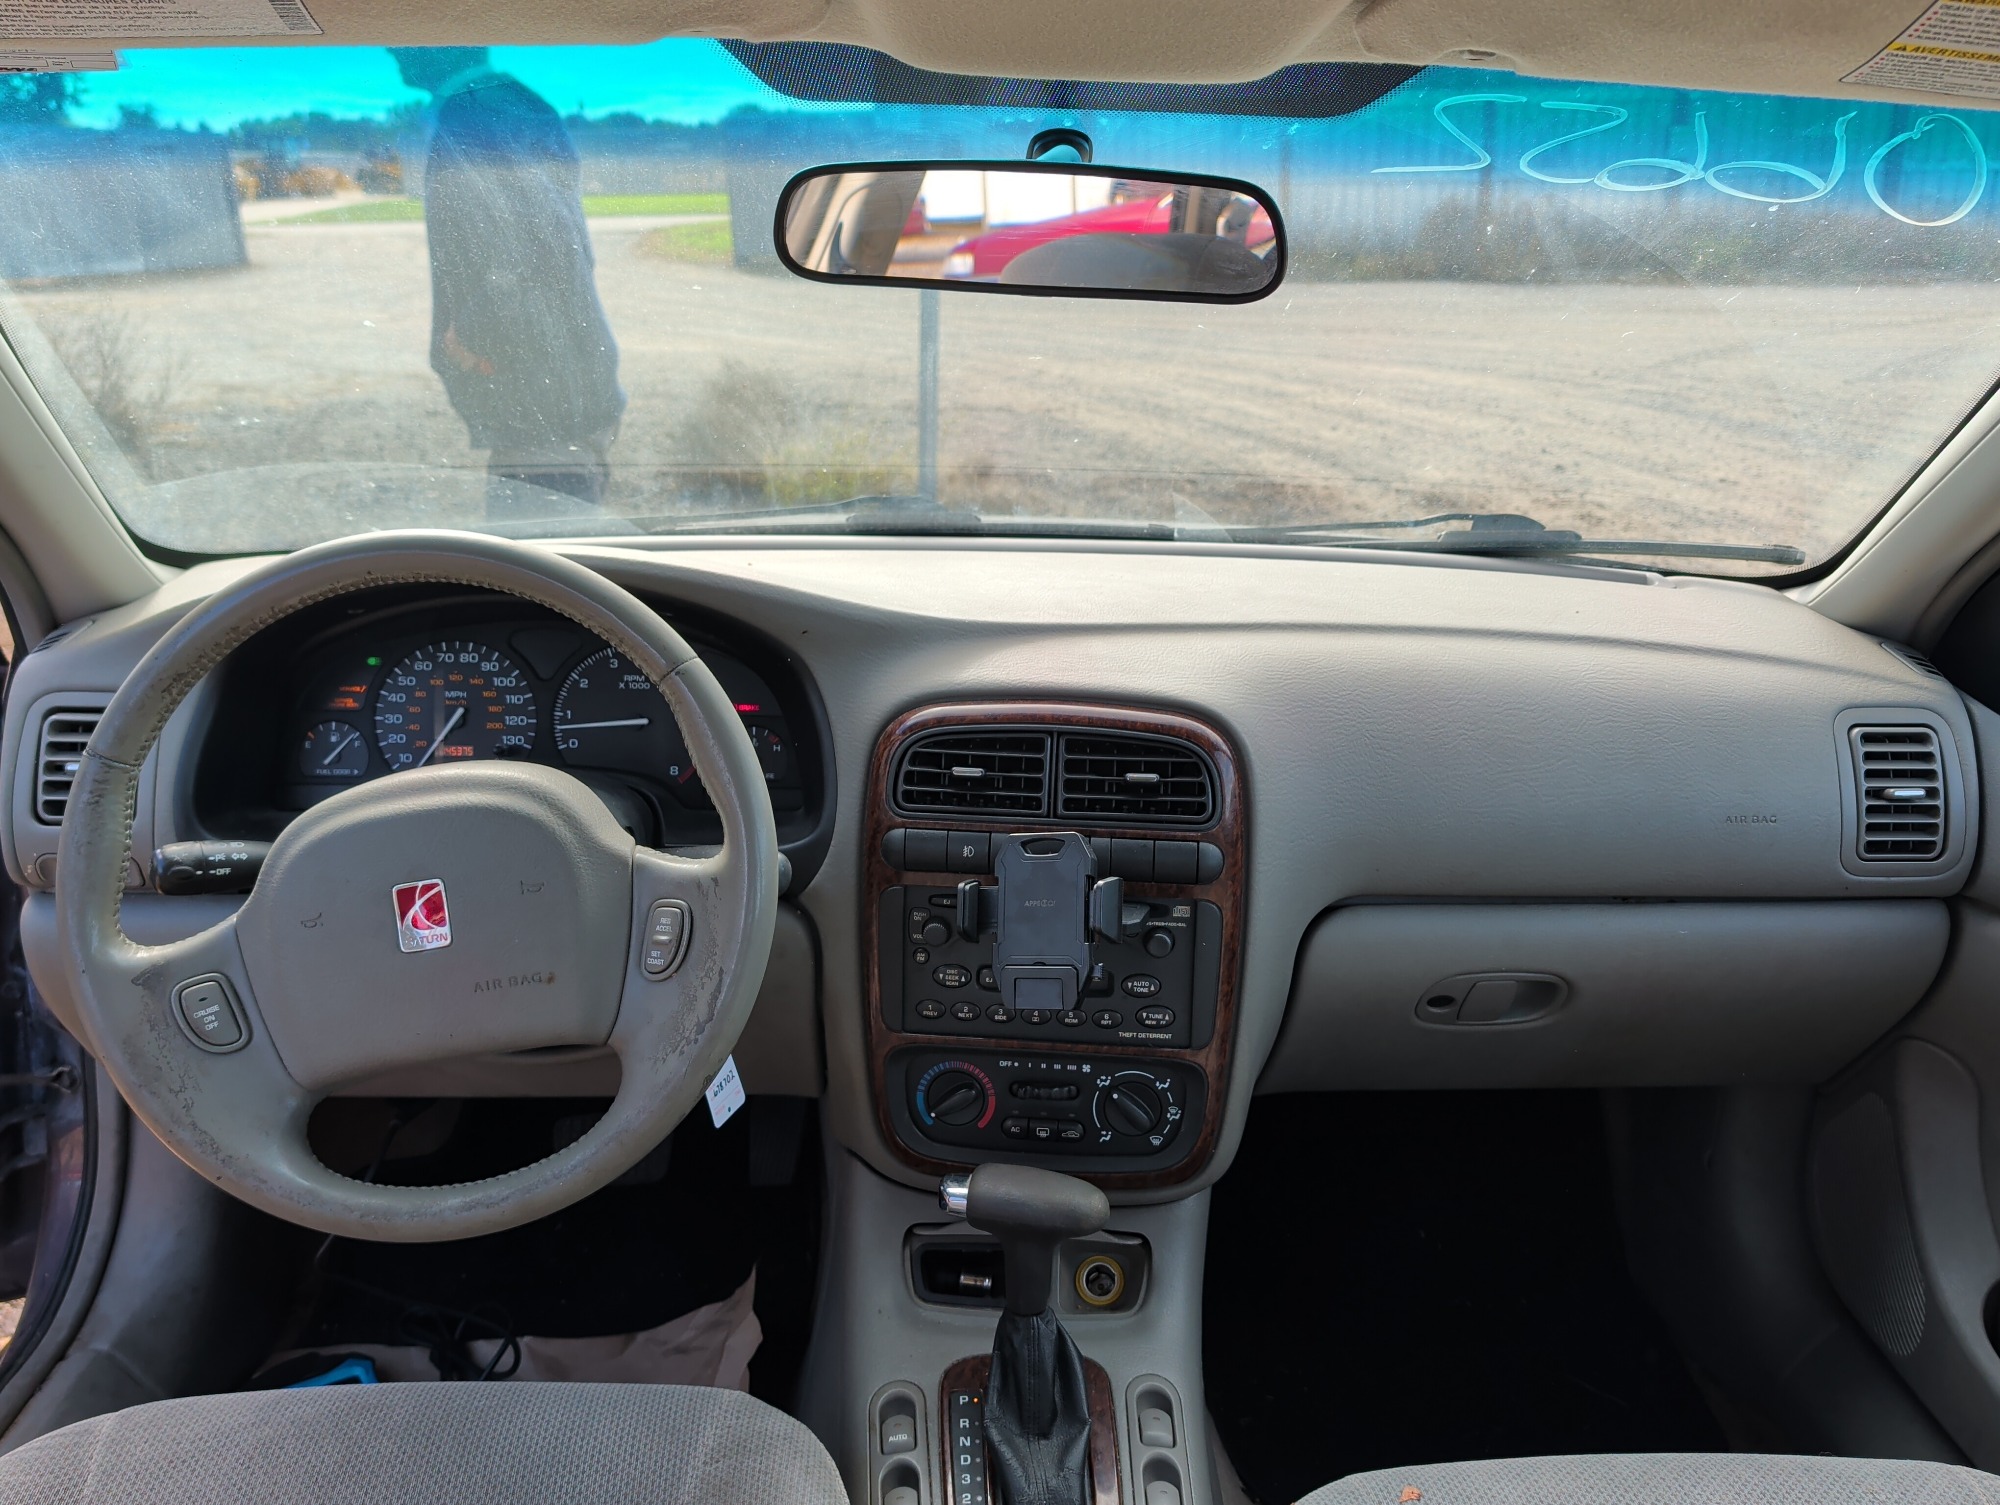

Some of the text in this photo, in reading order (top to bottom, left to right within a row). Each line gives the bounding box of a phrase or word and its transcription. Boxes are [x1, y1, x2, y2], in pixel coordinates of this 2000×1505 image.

[437, 653, 454, 663] 70
[460, 654, 479, 663] 80
[414, 661, 432, 671] 60
[481, 662, 500, 672] 90
[610, 660, 618, 668] 3
[398, 676, 416, 686] 50
[493, 677, 516, 687] 100
[580, 679, 589, 688] 2
[628, 682, 650, 690] 1000
[388, 693, 406, 704] 40
[444, 690, 467, 698] MPH
[506, 694, 524, 704] 110
[384, 714, 402, 724] 30
[566, 710, 572, 720] 1
[504, 716, 528, 726] 120
[388, 733, 406, 744] 20
[502, 736, 525, 746] 130
[569, 739, 578, 748] 0
[304, 741, 312, 749] E
[399, 753, 412, 764] 10
[670, 766, 679, 776] 8
[1725, 815, 1777, 824] AIR BAG
[216, 868, 232, 876] OFF
[647, 958, 665, 966] COAST
[474, 972, 543, 993] AIR BAG
[194, 1004, 220, 1019] CRUISE
[204, 1014, 216, 1023] ON
[205, 1021, 219, 1031] OFF
[959, 1396, 970, 1406] P
[960, 1418, 970, 1428] R
[888, 1434, 908, 1443] AUTO
[960, 1437, 971, 1447] N
[960, 1455, 971, 1465] D
[961, 1474, 971, 1484] 3
[962, 1494, 972, 1504] 2
